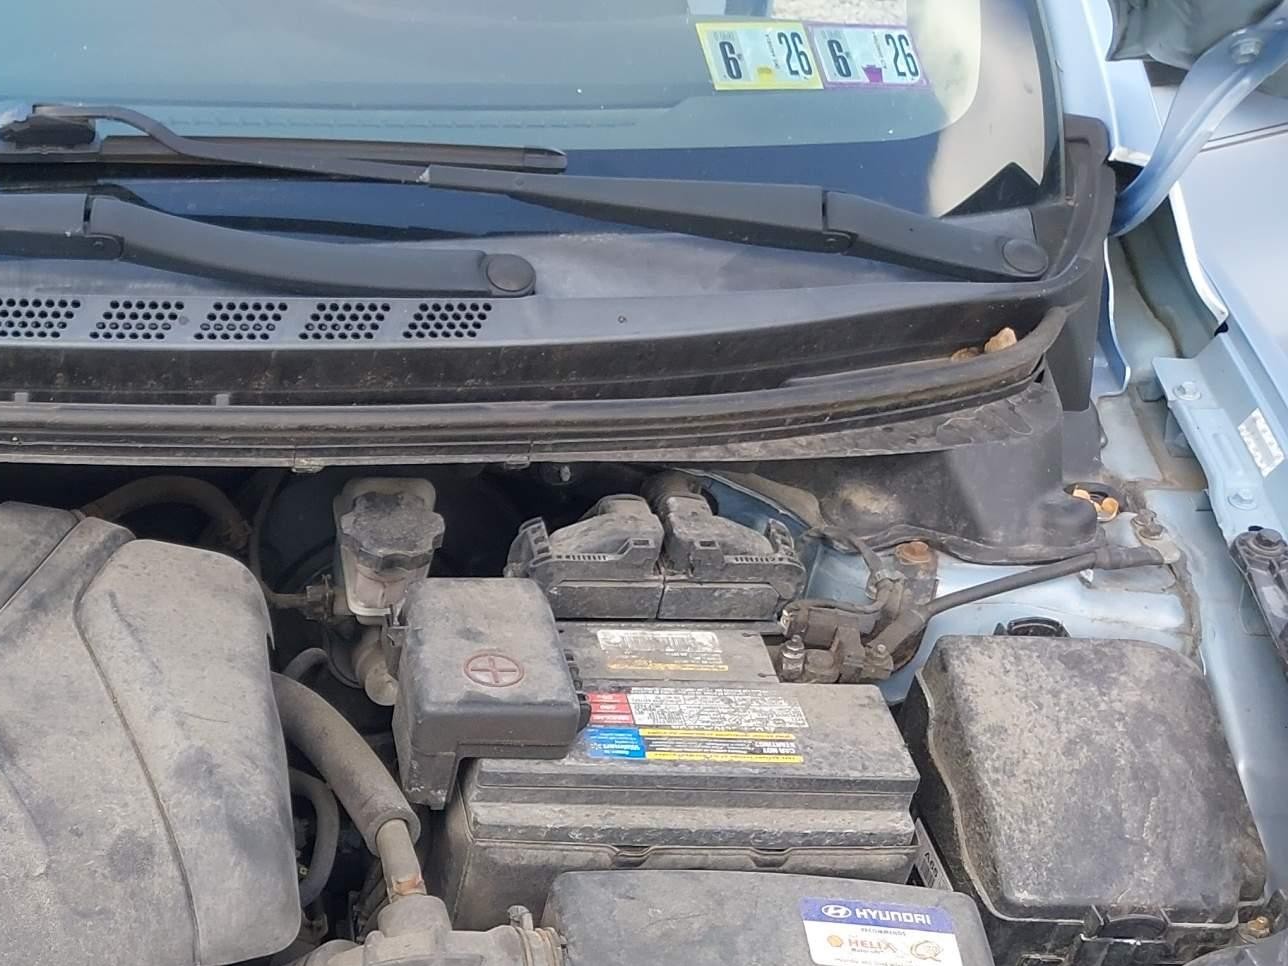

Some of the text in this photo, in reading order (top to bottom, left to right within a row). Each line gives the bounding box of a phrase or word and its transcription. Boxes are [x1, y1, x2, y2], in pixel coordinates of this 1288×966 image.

[719, 41, 742, 80] 6
[776, 31, 813, 76] 26
[827, 39, 852, 78] 6
[884, 33, 920, 77] 26
[854, 907, 932, 926] HYUNDAI
